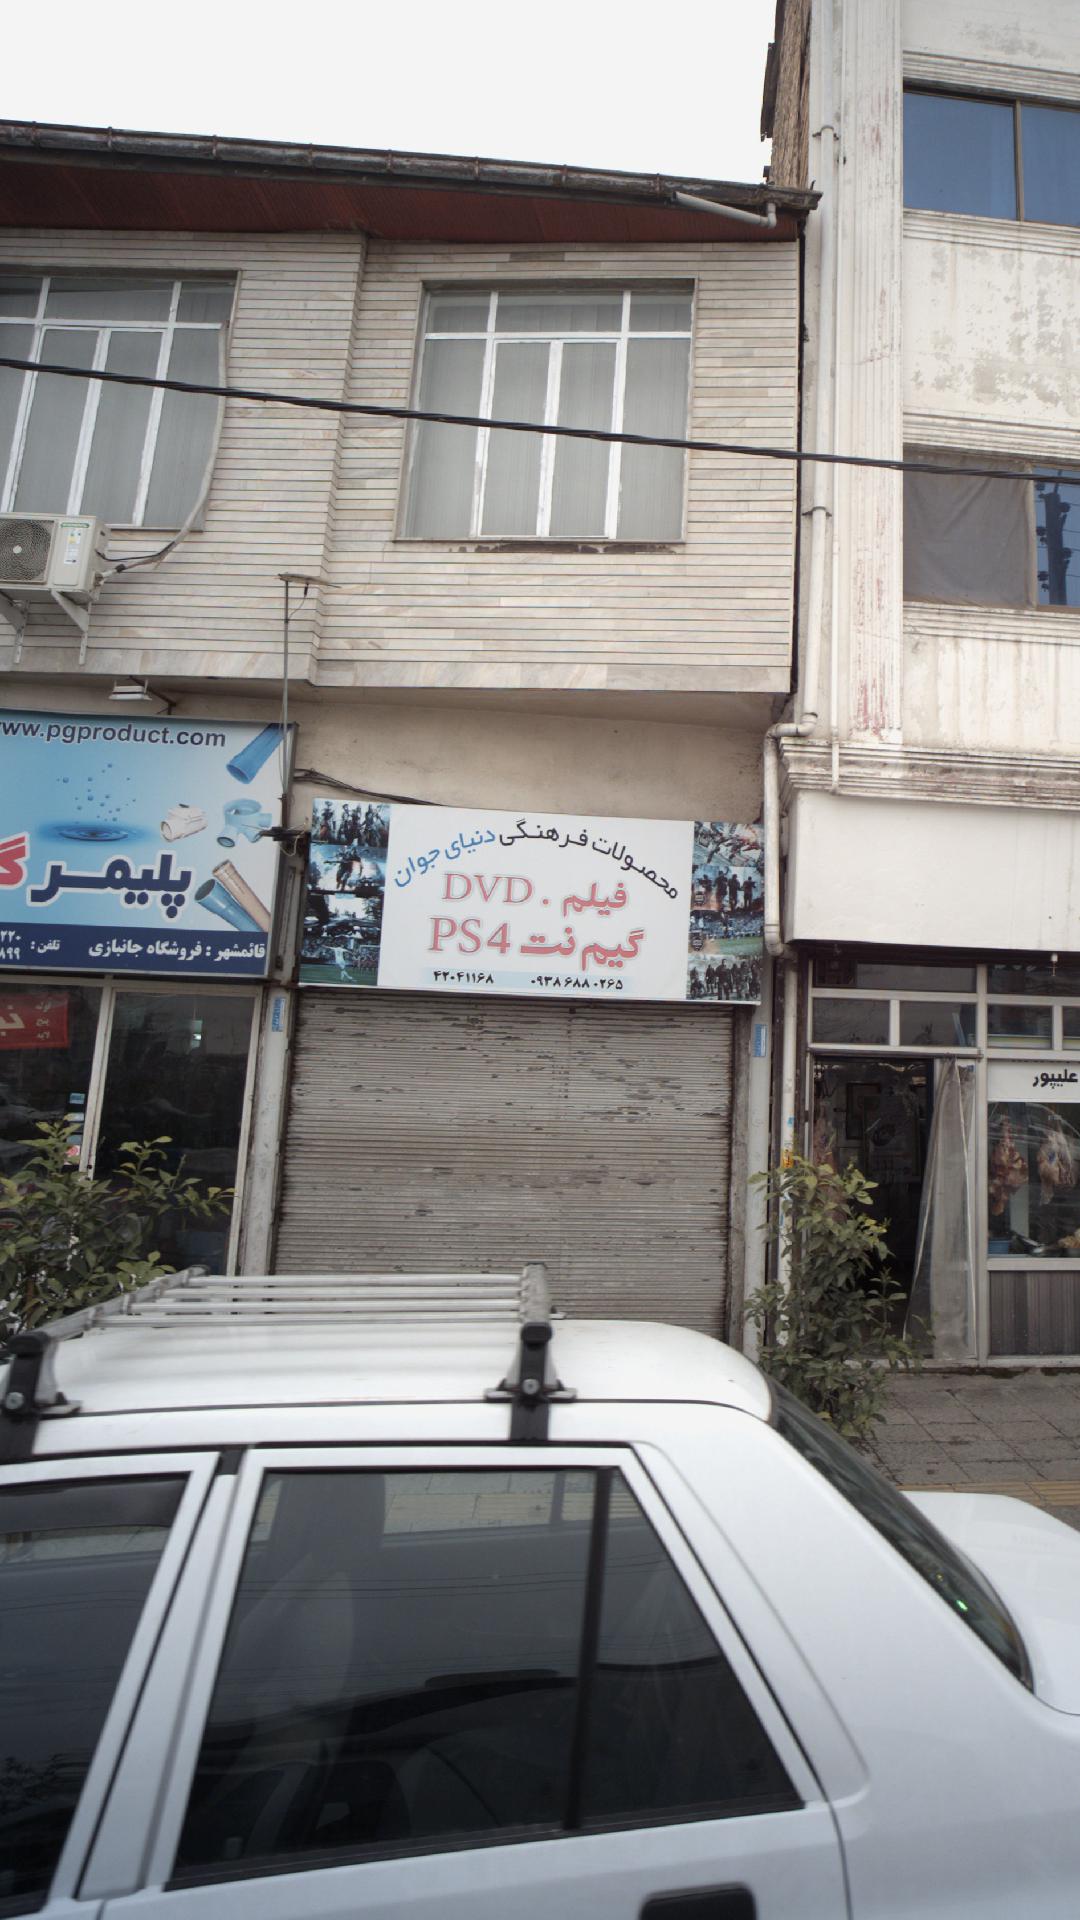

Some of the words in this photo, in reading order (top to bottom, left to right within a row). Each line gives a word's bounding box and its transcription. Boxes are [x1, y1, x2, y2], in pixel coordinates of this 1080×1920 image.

[0, 721, 226, 747] ww.pgproduct.com
[445, 829, 496, 860] دنیای
[499, 818, 589, 848] فرهنگی
[394, 848, 440, 888] جوان
[592, 838, 678, 899] محصولات
[30, 854, 192, 919] پلیمر
[441, 872, 533, 904] DVD
[563, 882, 628, 916] فیلم
[88, 938, 144, 958] جانبازی
[146, 940, 202, 961] فروشگاه
[428, 917, 511, 954] PS4
[519, 926, 577, 956] نت
[581, 929, 645, 971] گیم
[1032, 1068, 1079, 1089] علیپور
